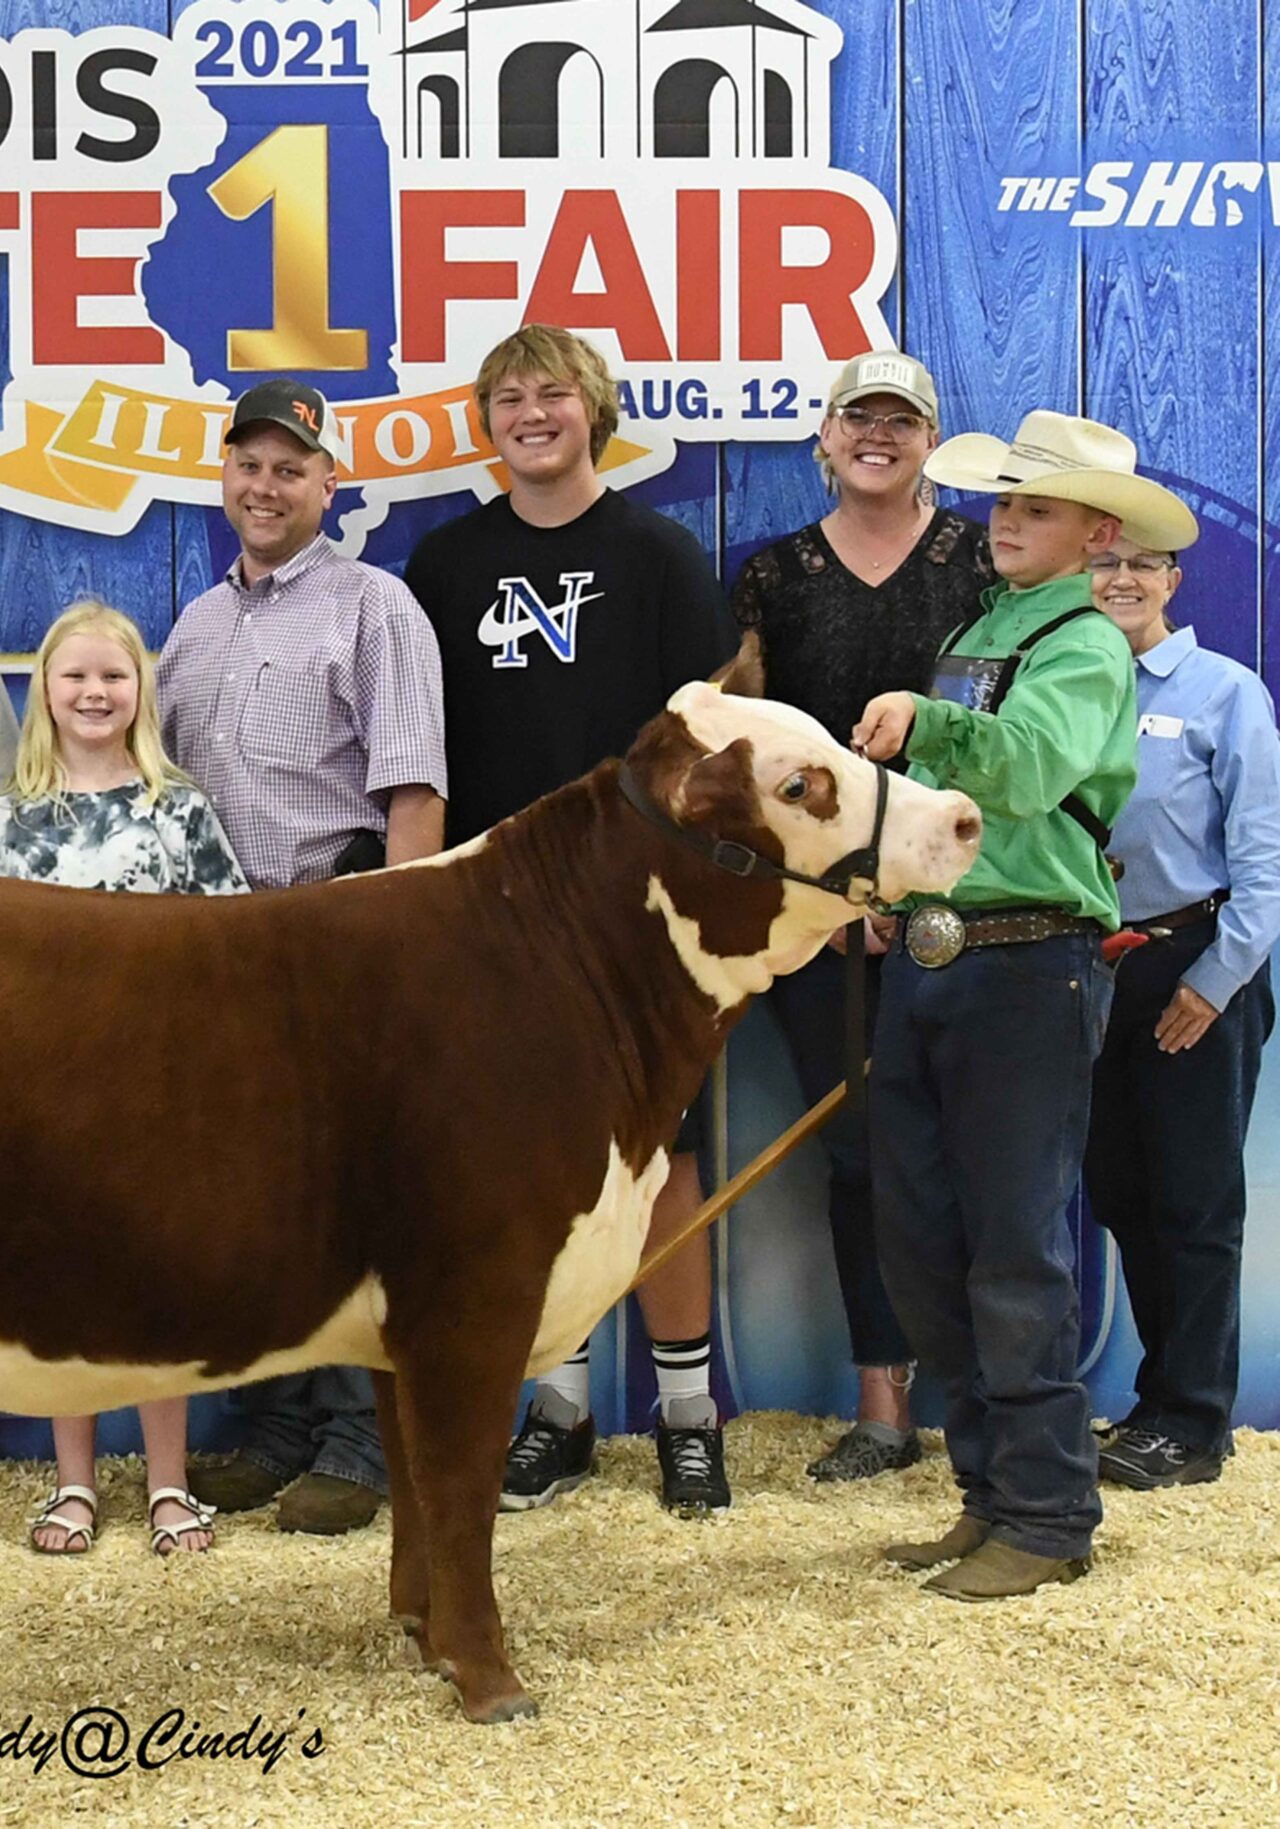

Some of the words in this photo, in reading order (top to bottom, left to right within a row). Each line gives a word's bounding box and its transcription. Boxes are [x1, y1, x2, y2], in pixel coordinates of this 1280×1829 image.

[197, 20, 369, 77] 2021
[997, 177, 1081, 211] THE
[1070, 161, 1280, 227] SHO
[208, 124, 368, 371] 1
[400, 189, 875, 363] FAIR
[616, 379, 723, 419] AUG.
